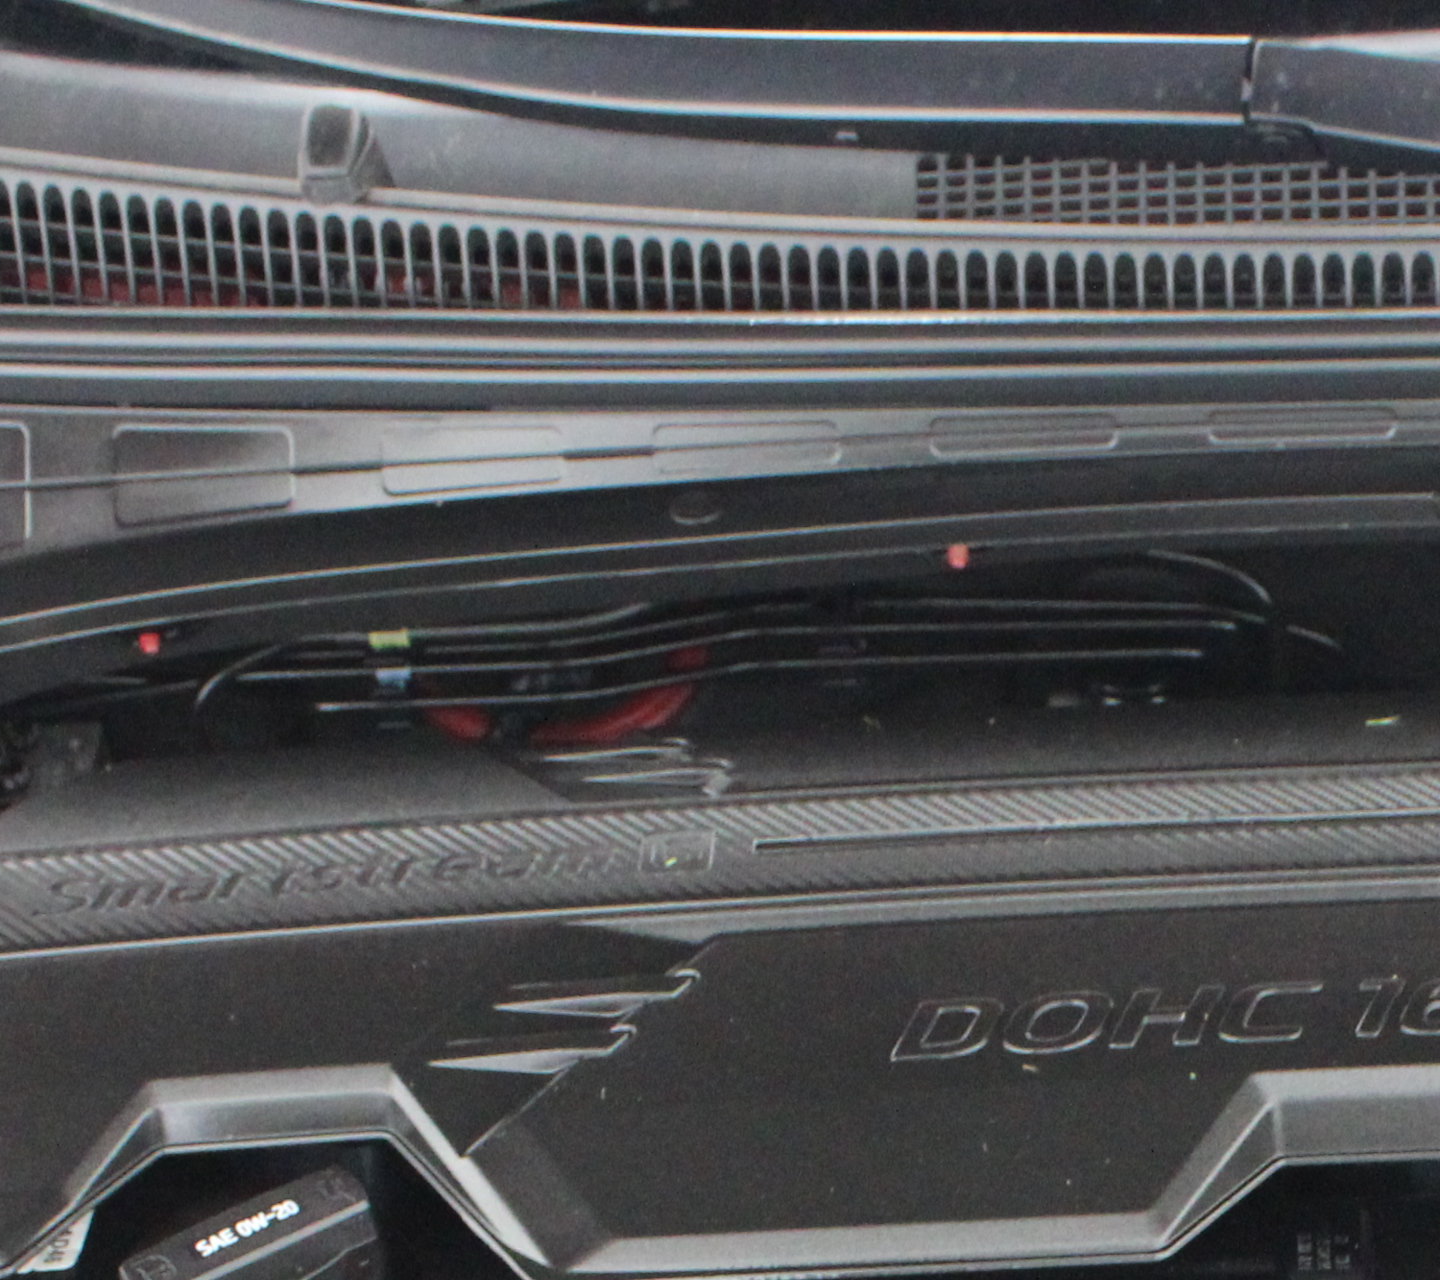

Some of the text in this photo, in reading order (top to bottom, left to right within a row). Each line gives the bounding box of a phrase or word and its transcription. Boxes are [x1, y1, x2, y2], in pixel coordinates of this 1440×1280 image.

[891, 982, 1324, 1064] DOHC
[195, 1198, 301, 1259] SAE 0W-20
